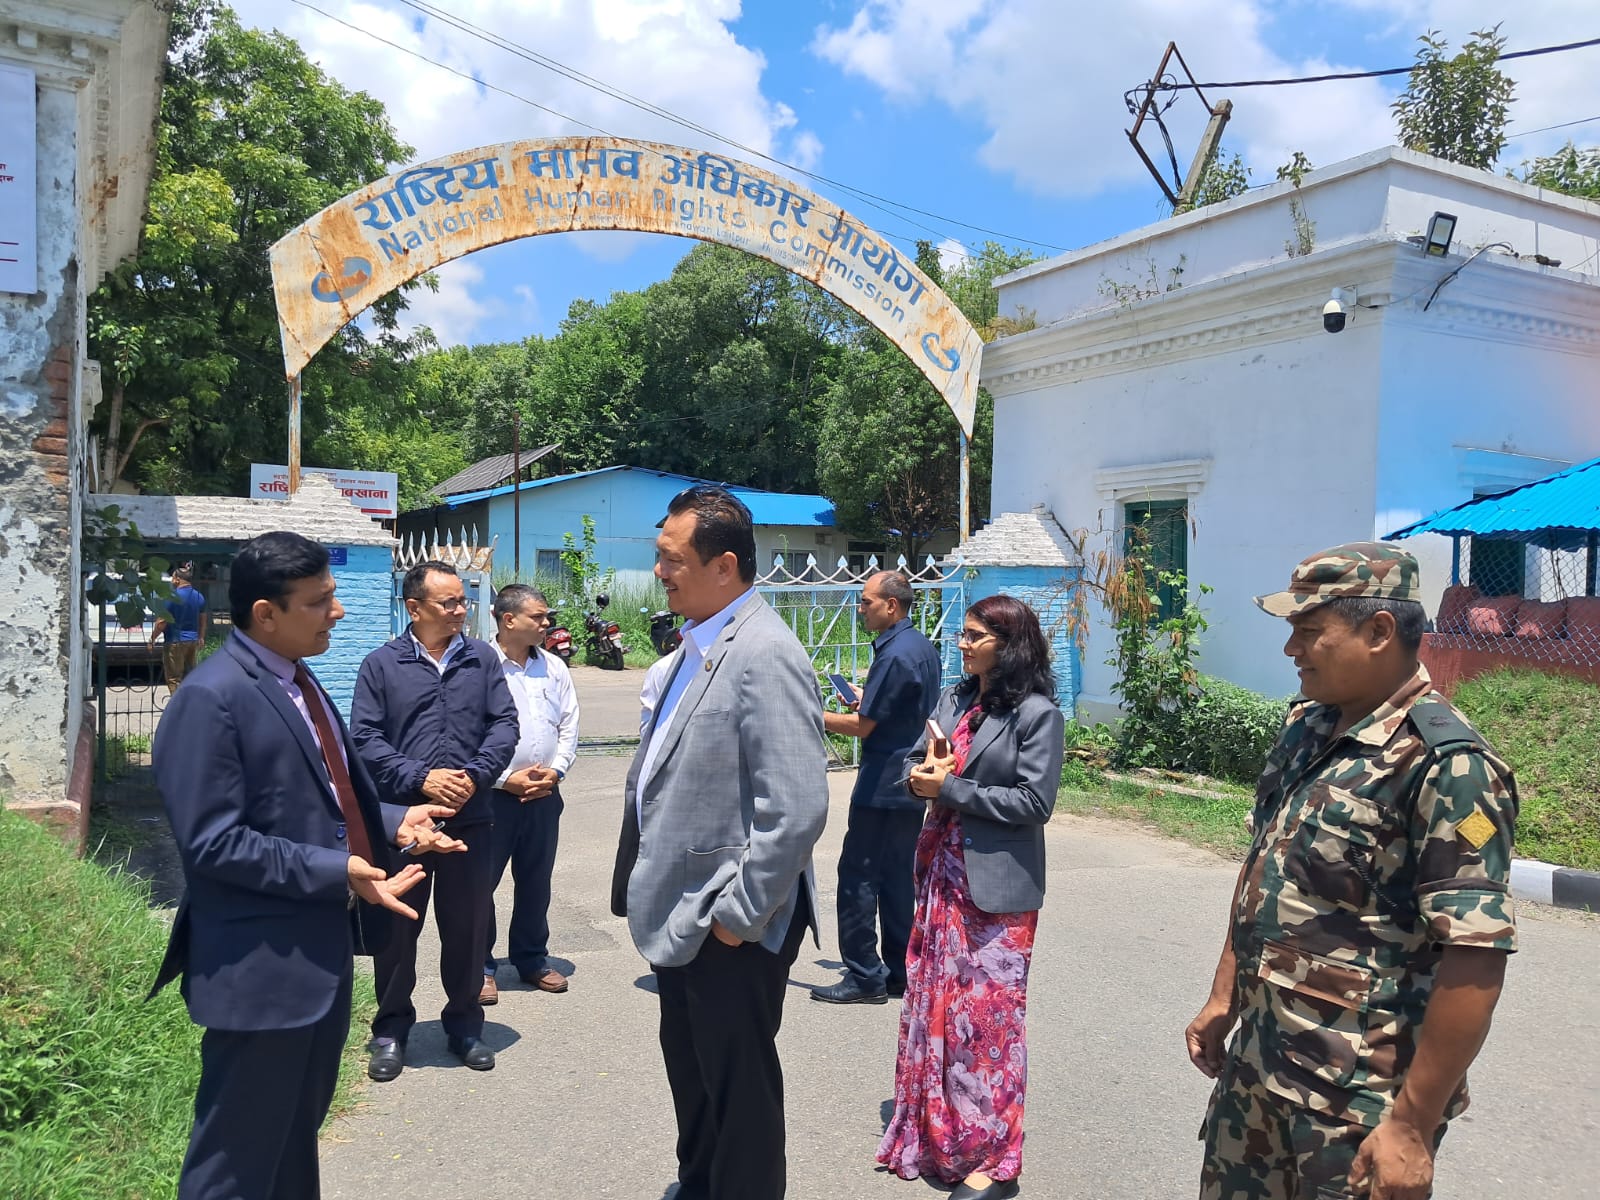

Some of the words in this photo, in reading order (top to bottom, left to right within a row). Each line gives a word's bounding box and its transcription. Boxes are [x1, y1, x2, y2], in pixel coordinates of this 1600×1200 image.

[353, 157, 499, 231] राष्ट्रिय
[525, 148, 644, 180] मानव
[660, 154, 815, 228] अधिकार
[817, 213, 929, 306] आयोग
[377, 195, 504, 261] National
[524, 187, 630, 212] Human
[652, 188, 747, 229] Rights
[769, 220, 905, 323] Commission
